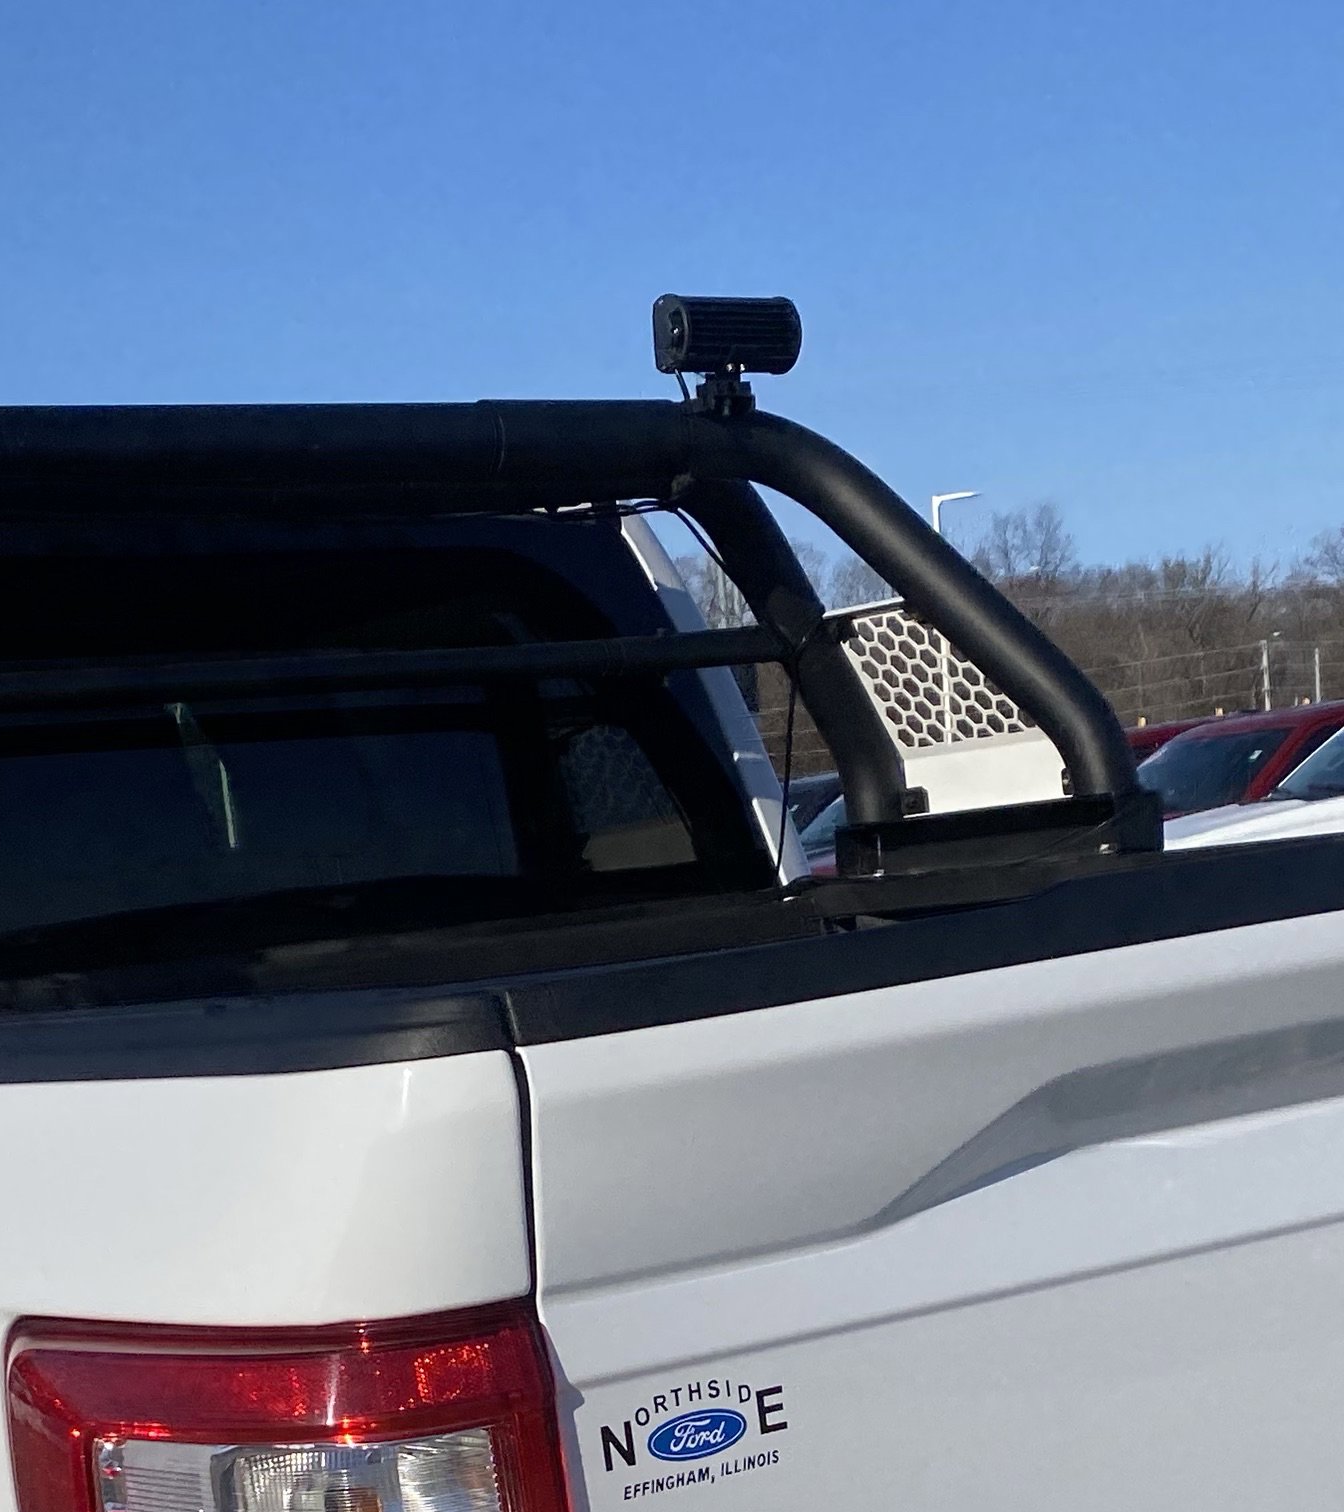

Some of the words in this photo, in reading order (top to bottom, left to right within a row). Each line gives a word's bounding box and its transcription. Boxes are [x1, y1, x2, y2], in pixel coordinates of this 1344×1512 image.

[600, 1379, 788, 1472] NORTHSIDE
[669, 1418, 726, 1453] Ford
[623, 1467, 716, 1501] EFFINGHAM,
[720, 1449, 780, 1476] ILLINOIS
